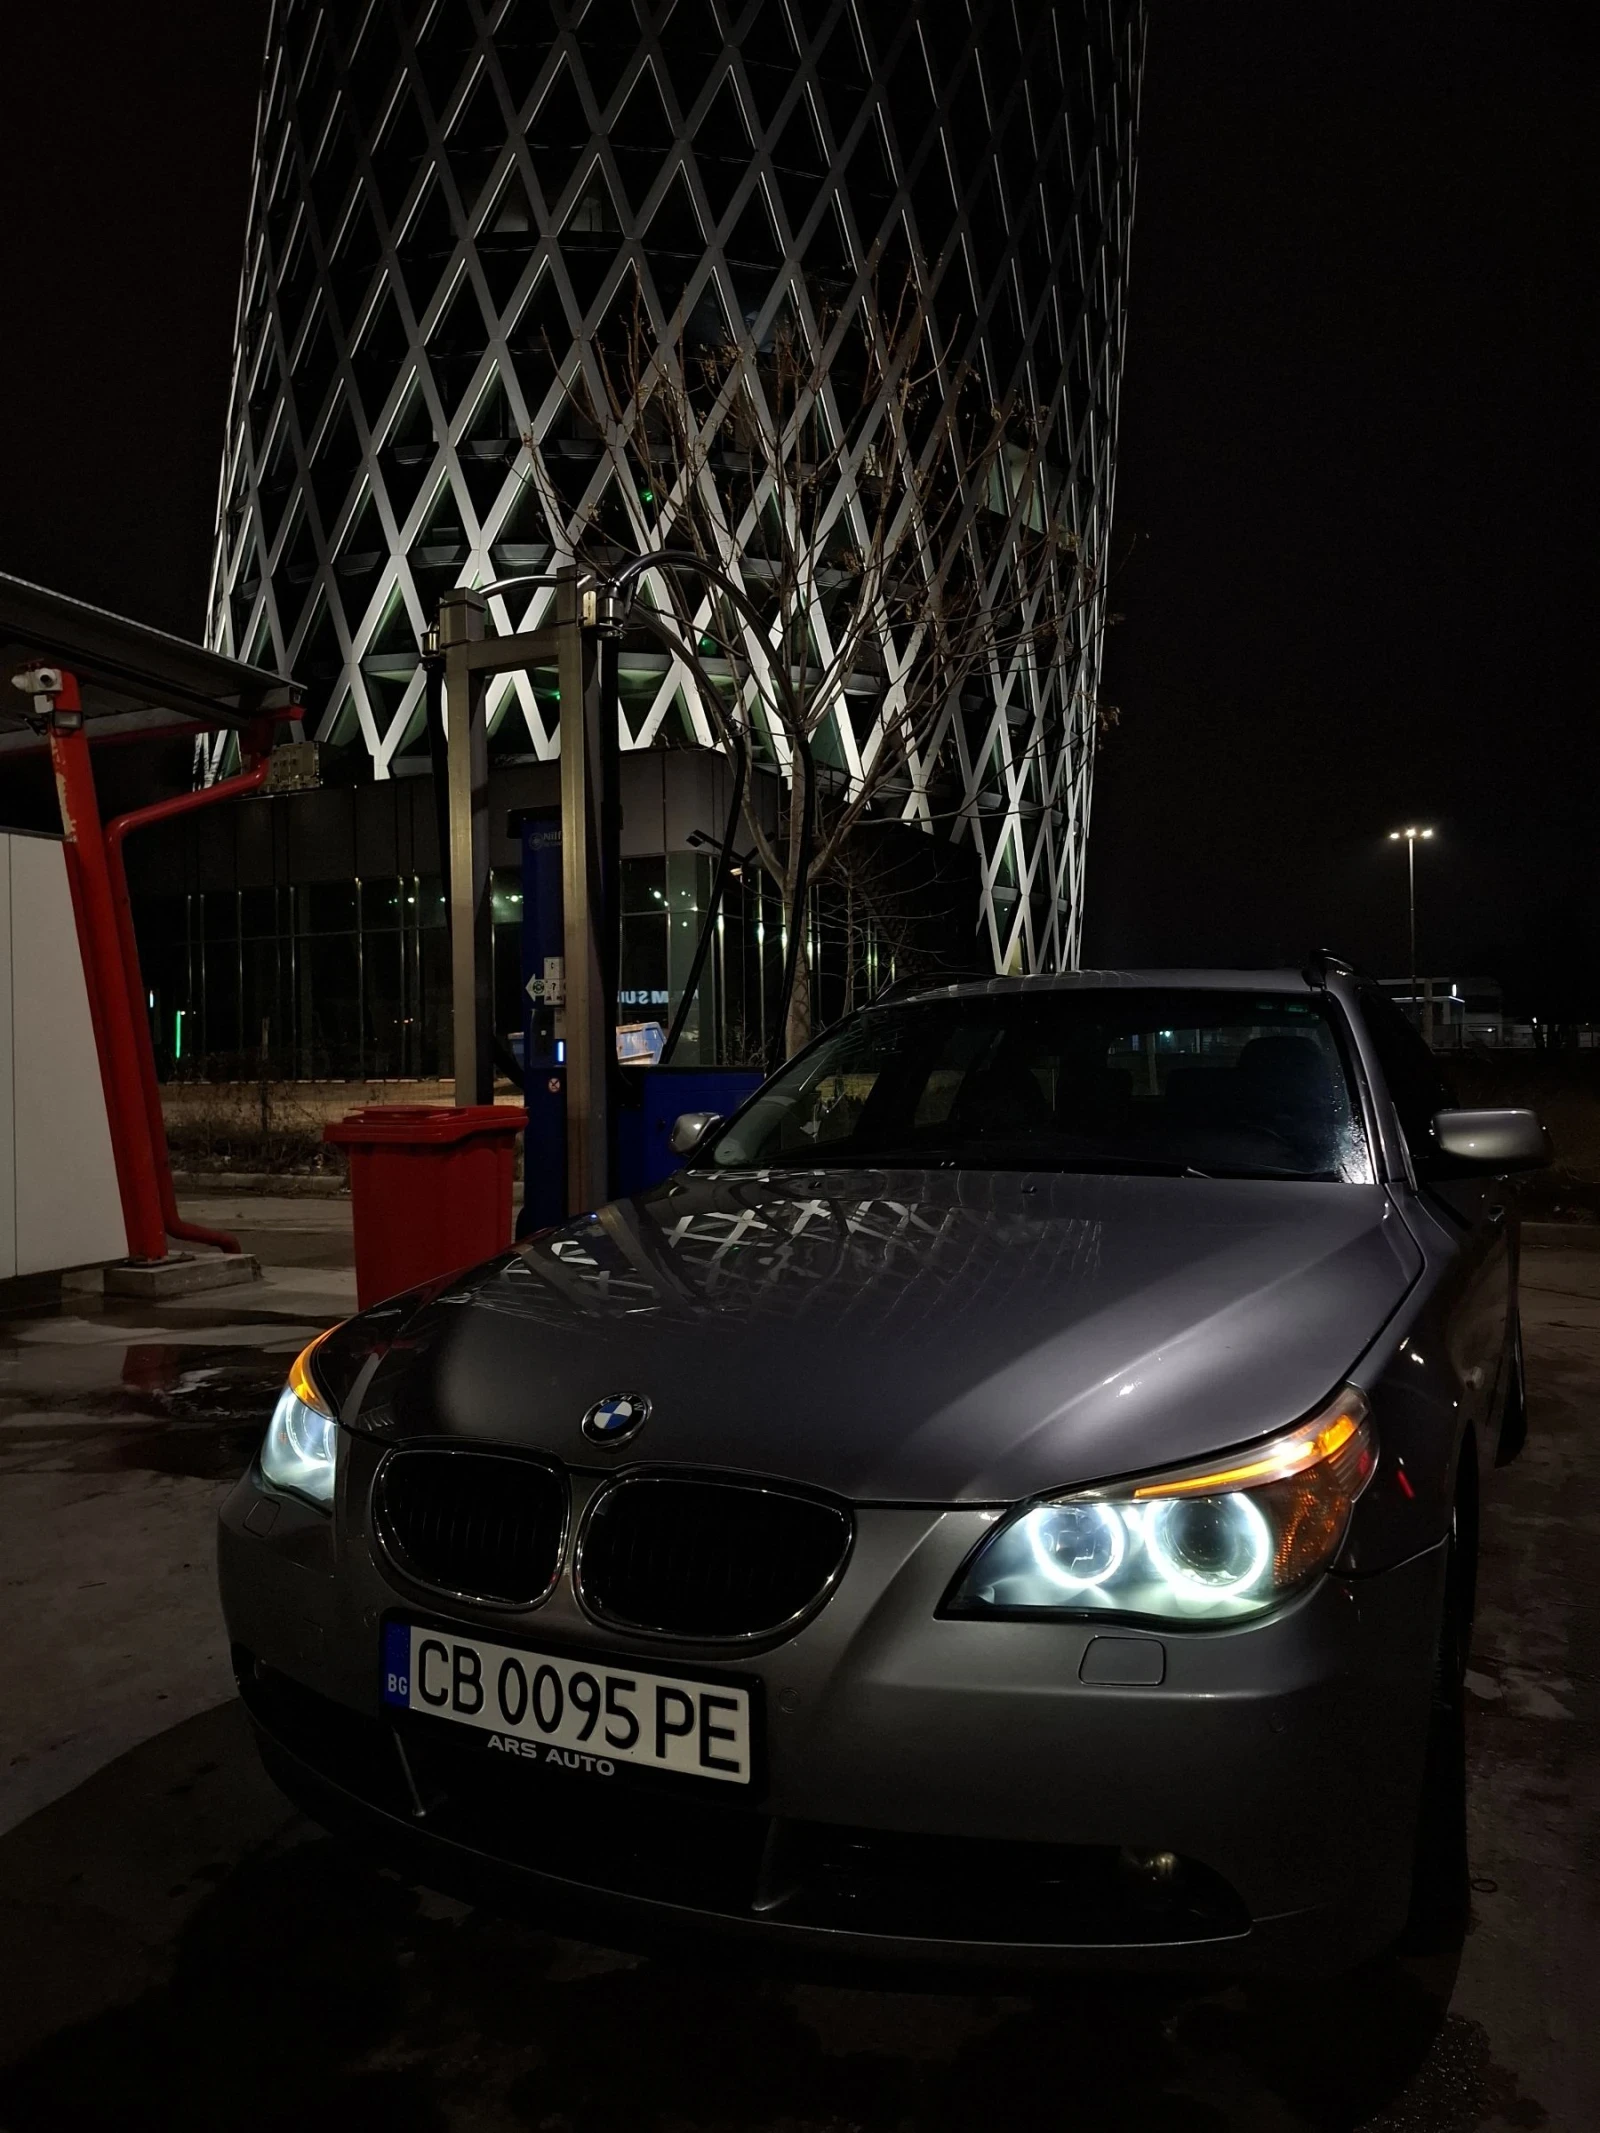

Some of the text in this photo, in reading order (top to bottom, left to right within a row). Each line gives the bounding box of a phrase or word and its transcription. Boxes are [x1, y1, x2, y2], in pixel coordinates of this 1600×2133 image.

[387, 1673, 408, 1695] BG
[418, 1639, 741, 1774] CB 0095 PE
[487, 1734, 615, 1777] ARS AUTO
